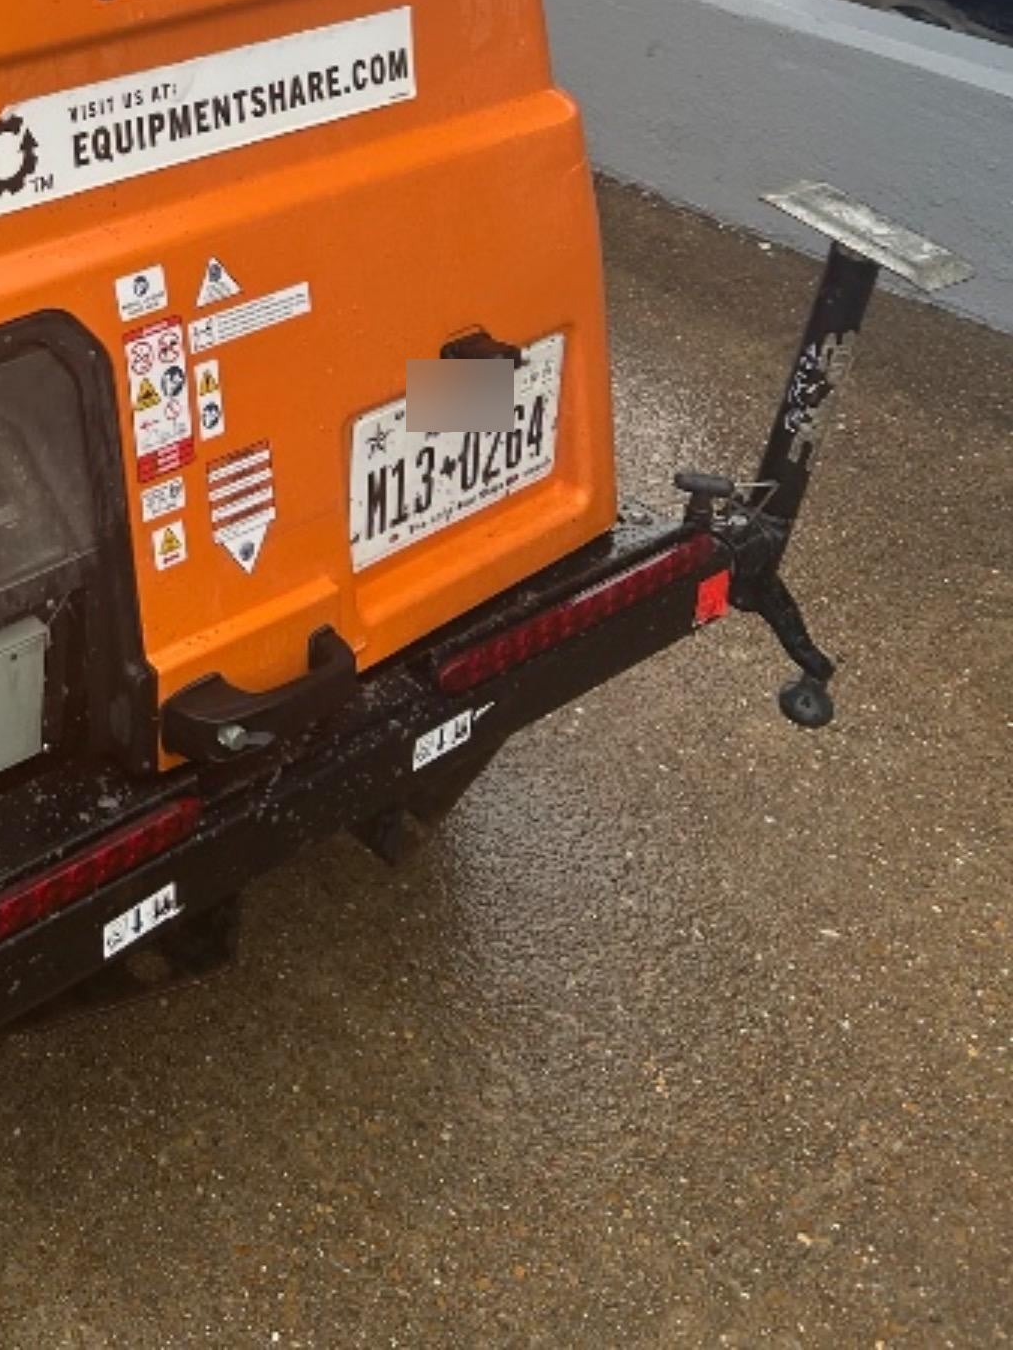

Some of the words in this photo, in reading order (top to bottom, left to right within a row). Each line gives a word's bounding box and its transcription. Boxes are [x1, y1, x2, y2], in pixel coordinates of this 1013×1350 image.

[67, 95, 116, 122] VISIT
[122, 88, 145, 109] US
[151, 83, 178, 104] AT:
[71, 47, 410, 168] EQUIPMENTSHARE.COM
